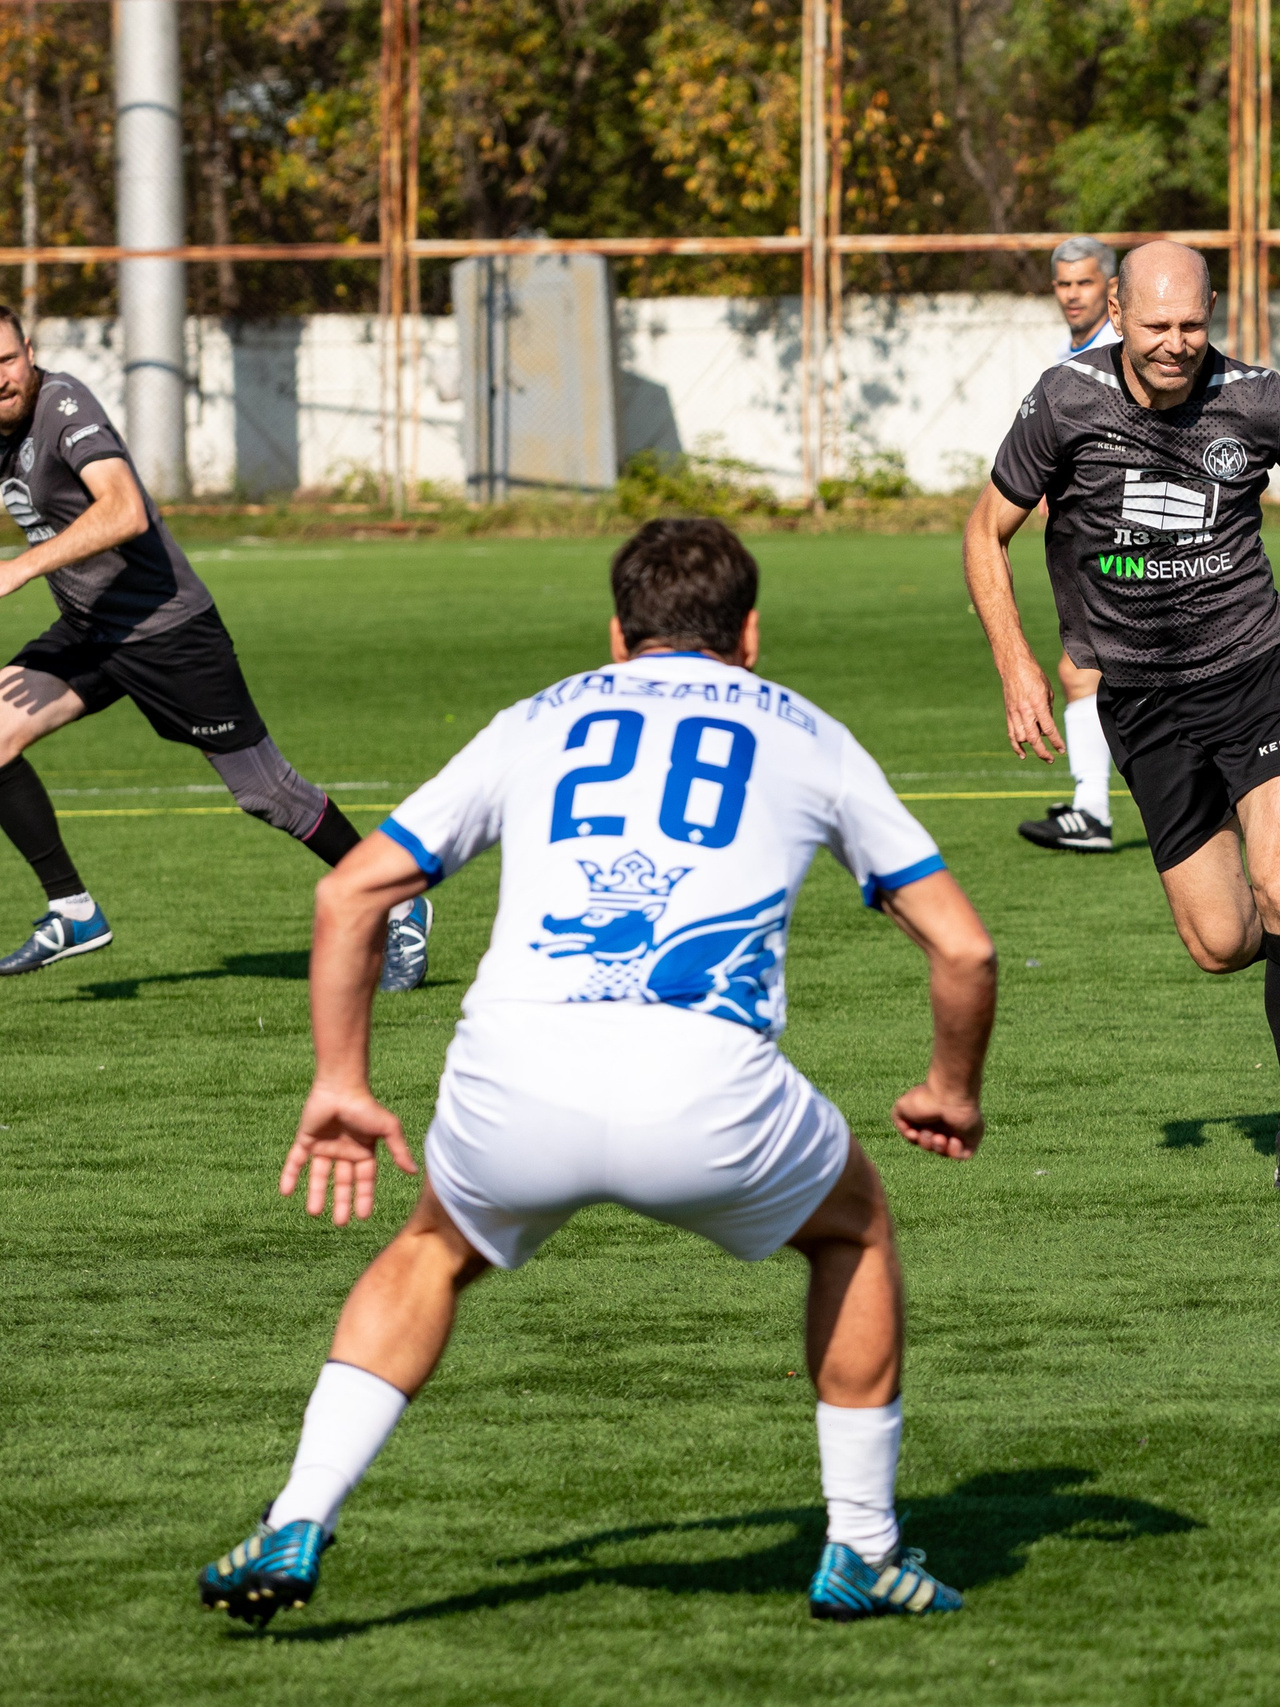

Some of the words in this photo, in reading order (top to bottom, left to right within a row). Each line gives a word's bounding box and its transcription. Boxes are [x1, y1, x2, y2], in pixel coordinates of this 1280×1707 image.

[1097, 441, 1127, 452] KELME
[192, 721, 236, 736] KELME
[549, 709, 757, 850] 28
